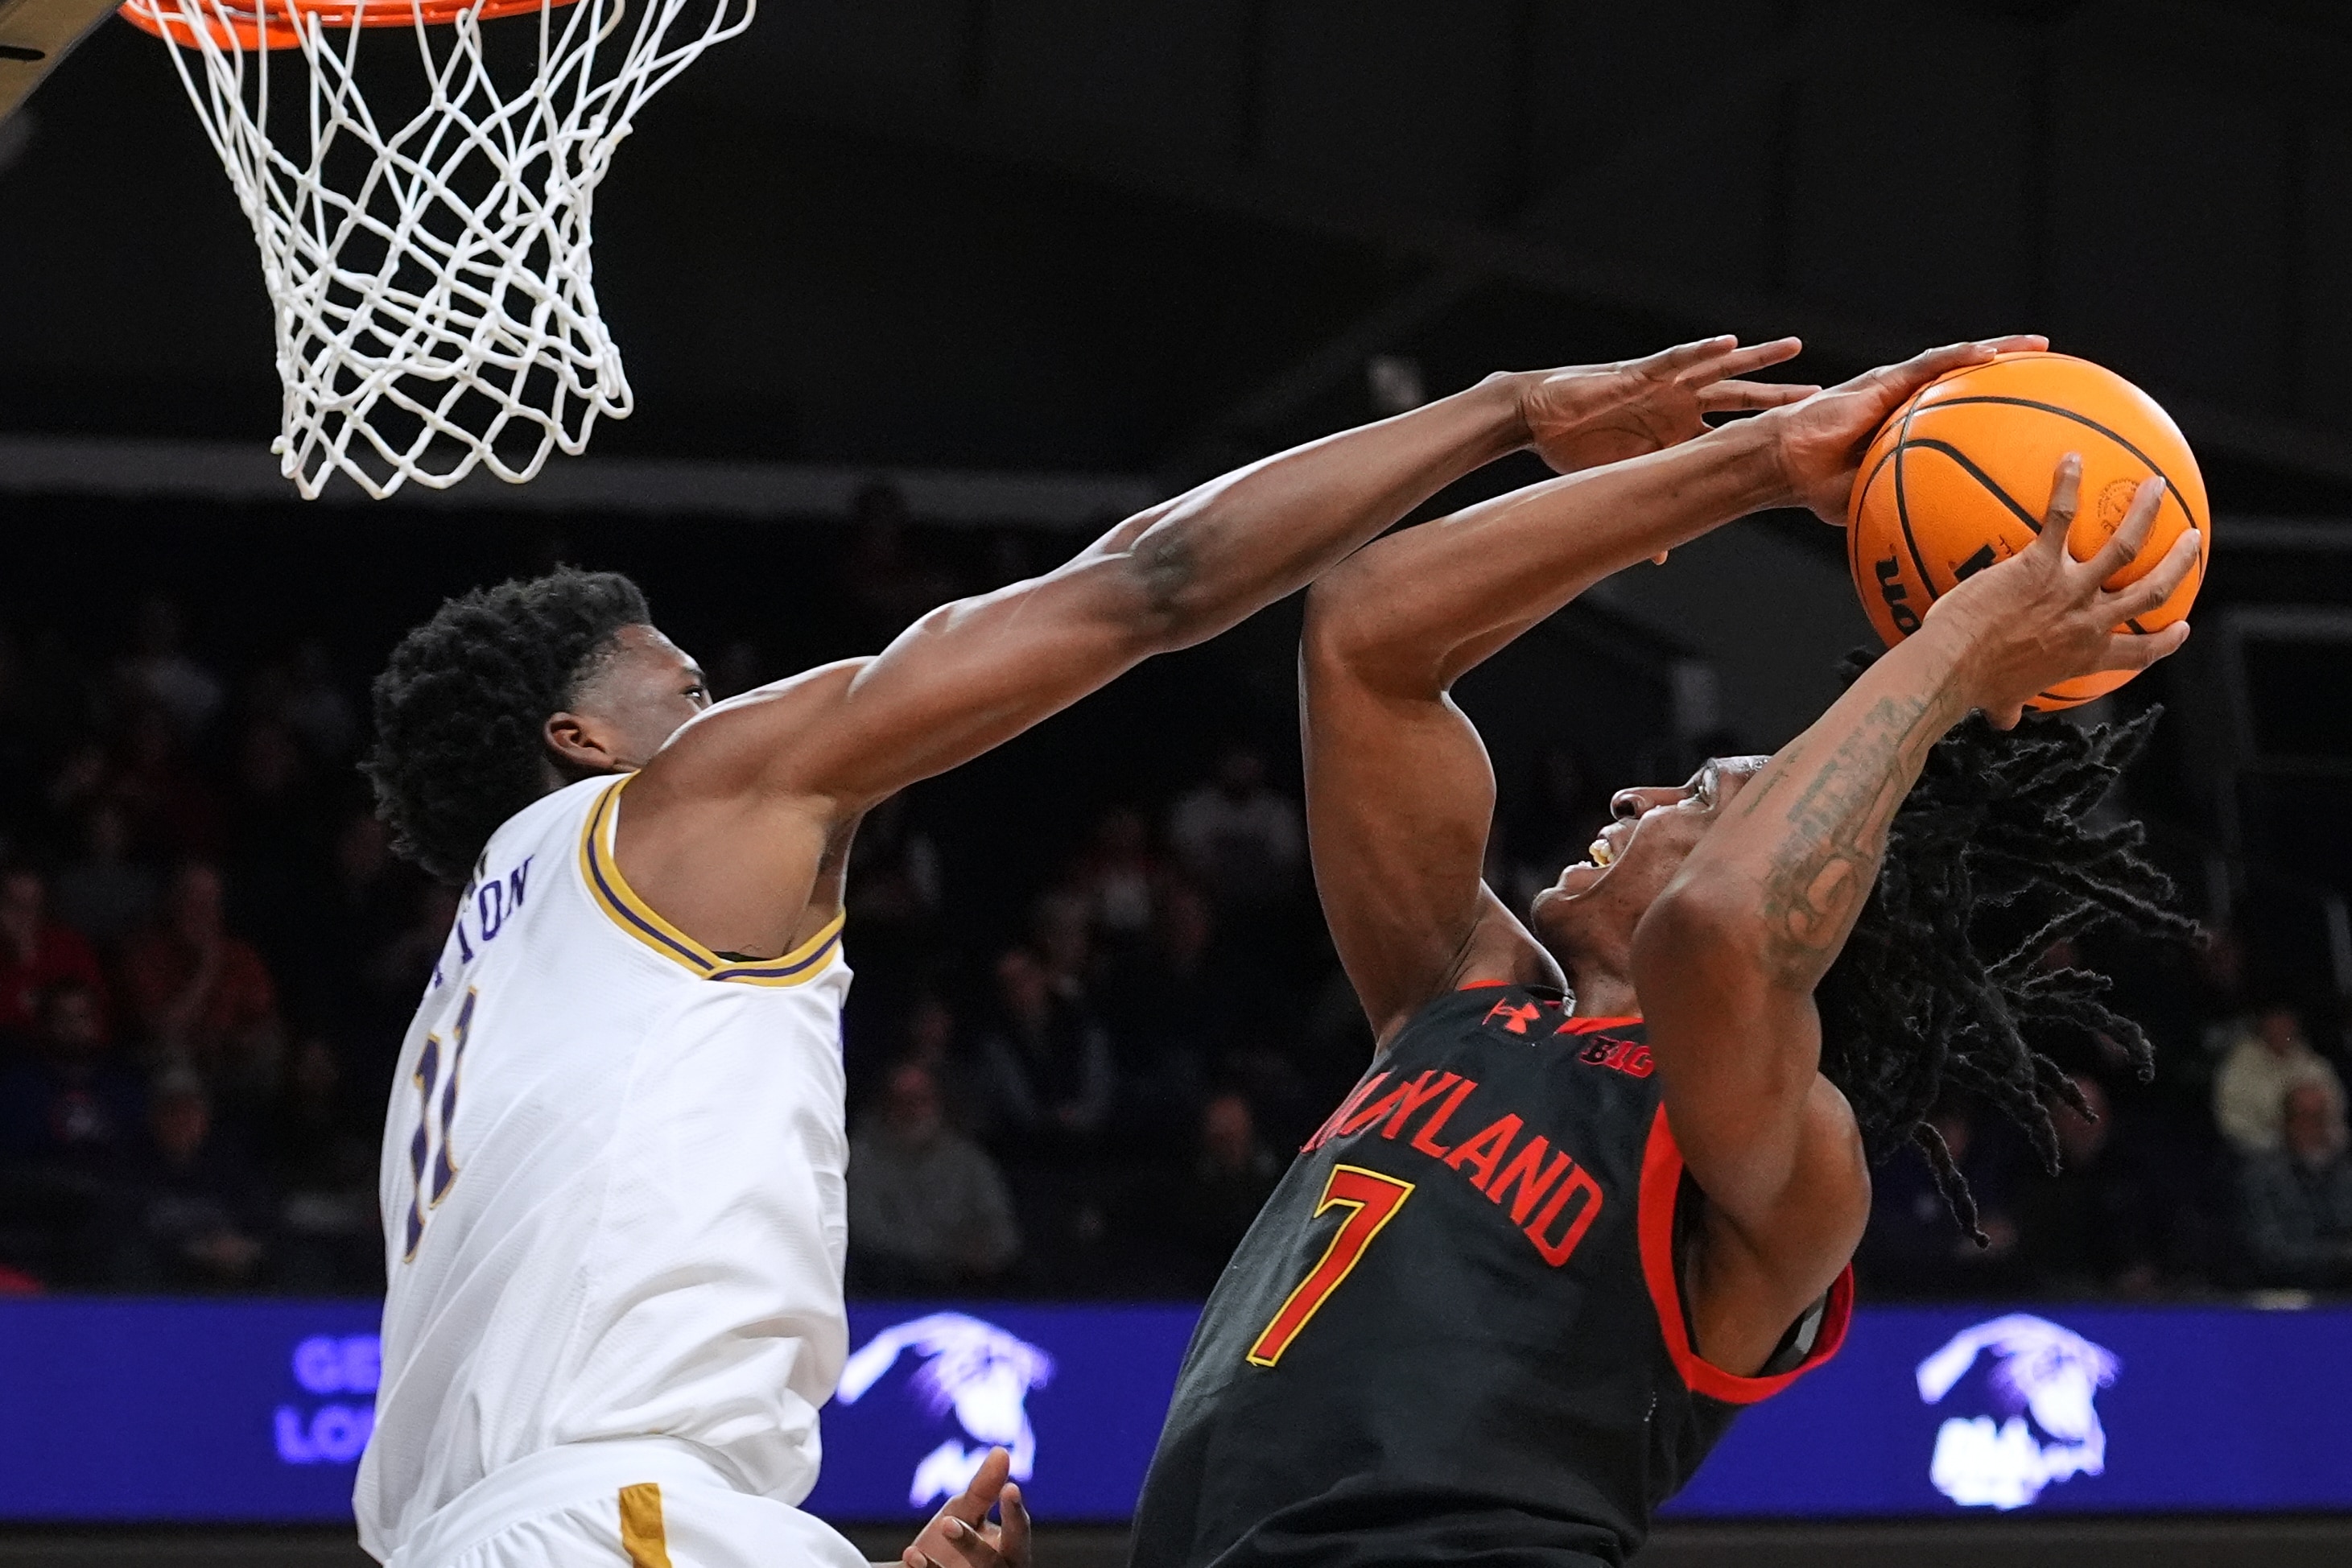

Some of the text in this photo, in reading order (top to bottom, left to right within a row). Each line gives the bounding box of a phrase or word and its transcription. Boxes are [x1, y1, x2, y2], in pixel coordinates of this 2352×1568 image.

[403, 985, 477, 1264] 11
[292, 1332, 381, 1395] GE
[1246, 1164, 1416, 1368] 7
